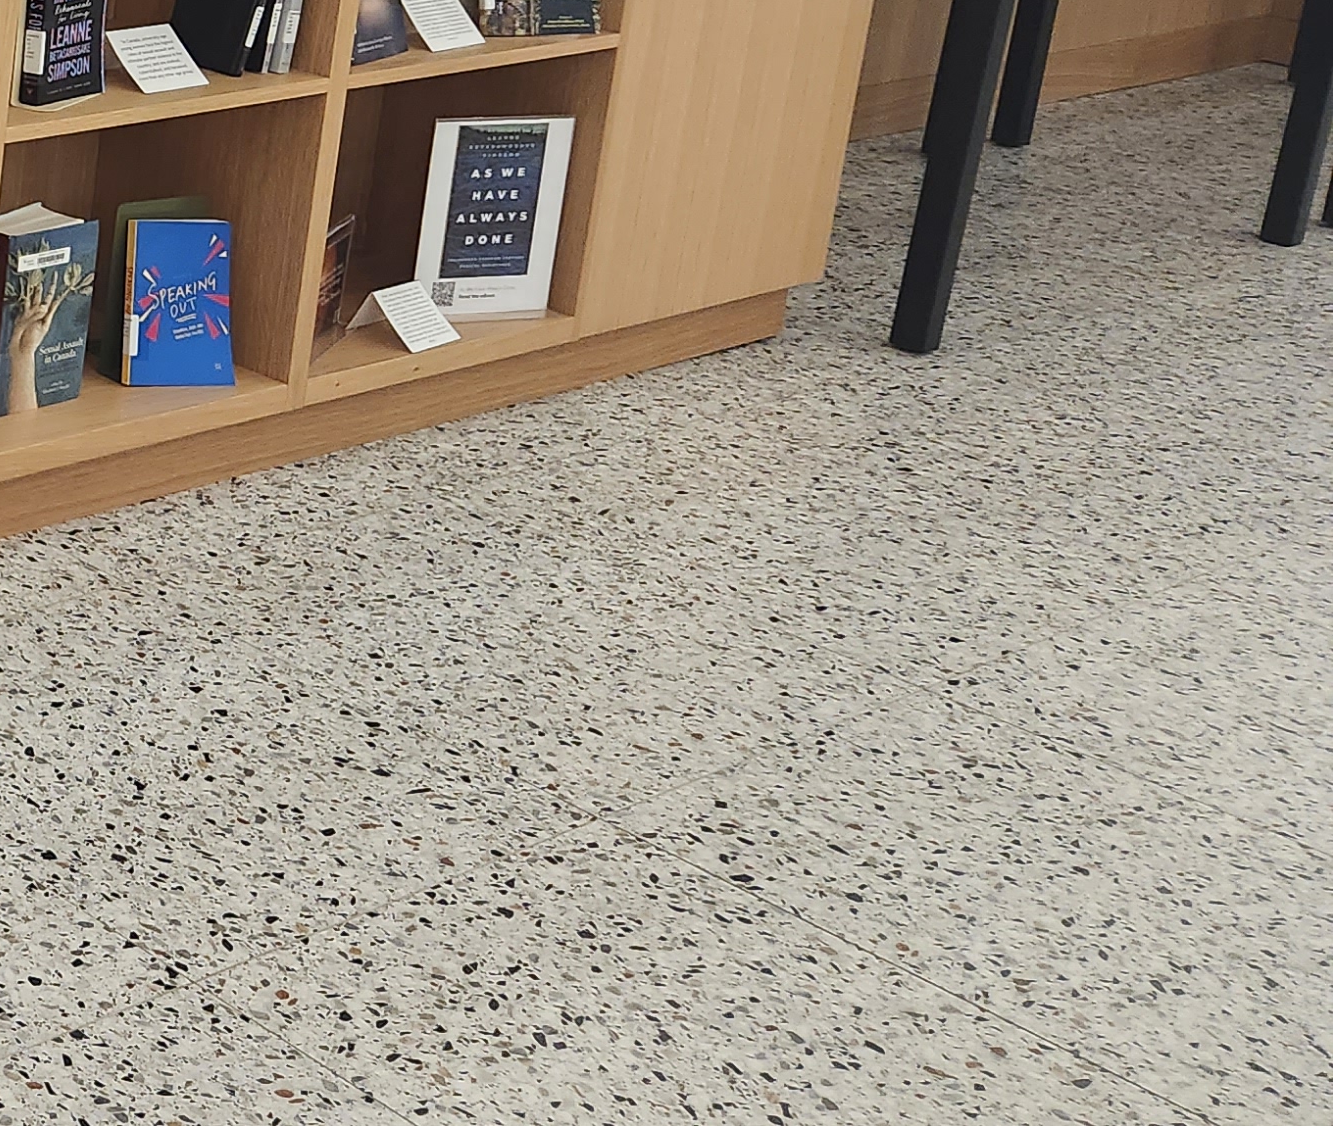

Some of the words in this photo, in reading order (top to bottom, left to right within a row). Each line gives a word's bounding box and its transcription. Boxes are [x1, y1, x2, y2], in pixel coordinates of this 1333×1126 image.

[50, 19, 93, 50] LEANNE
[47, 56, 90, 83] SIMPSON
[471, 169, 493, 179] AS
[501, 167, 526, 178] WE
[471, 190, 519, 201] HAVE
[455, 211, 528, 223] ALWAYS
[465, 234, 514, 245] DONE
[146, 271, 217, 310] SPEAKING
[169, 297, 198, 318] OUT
